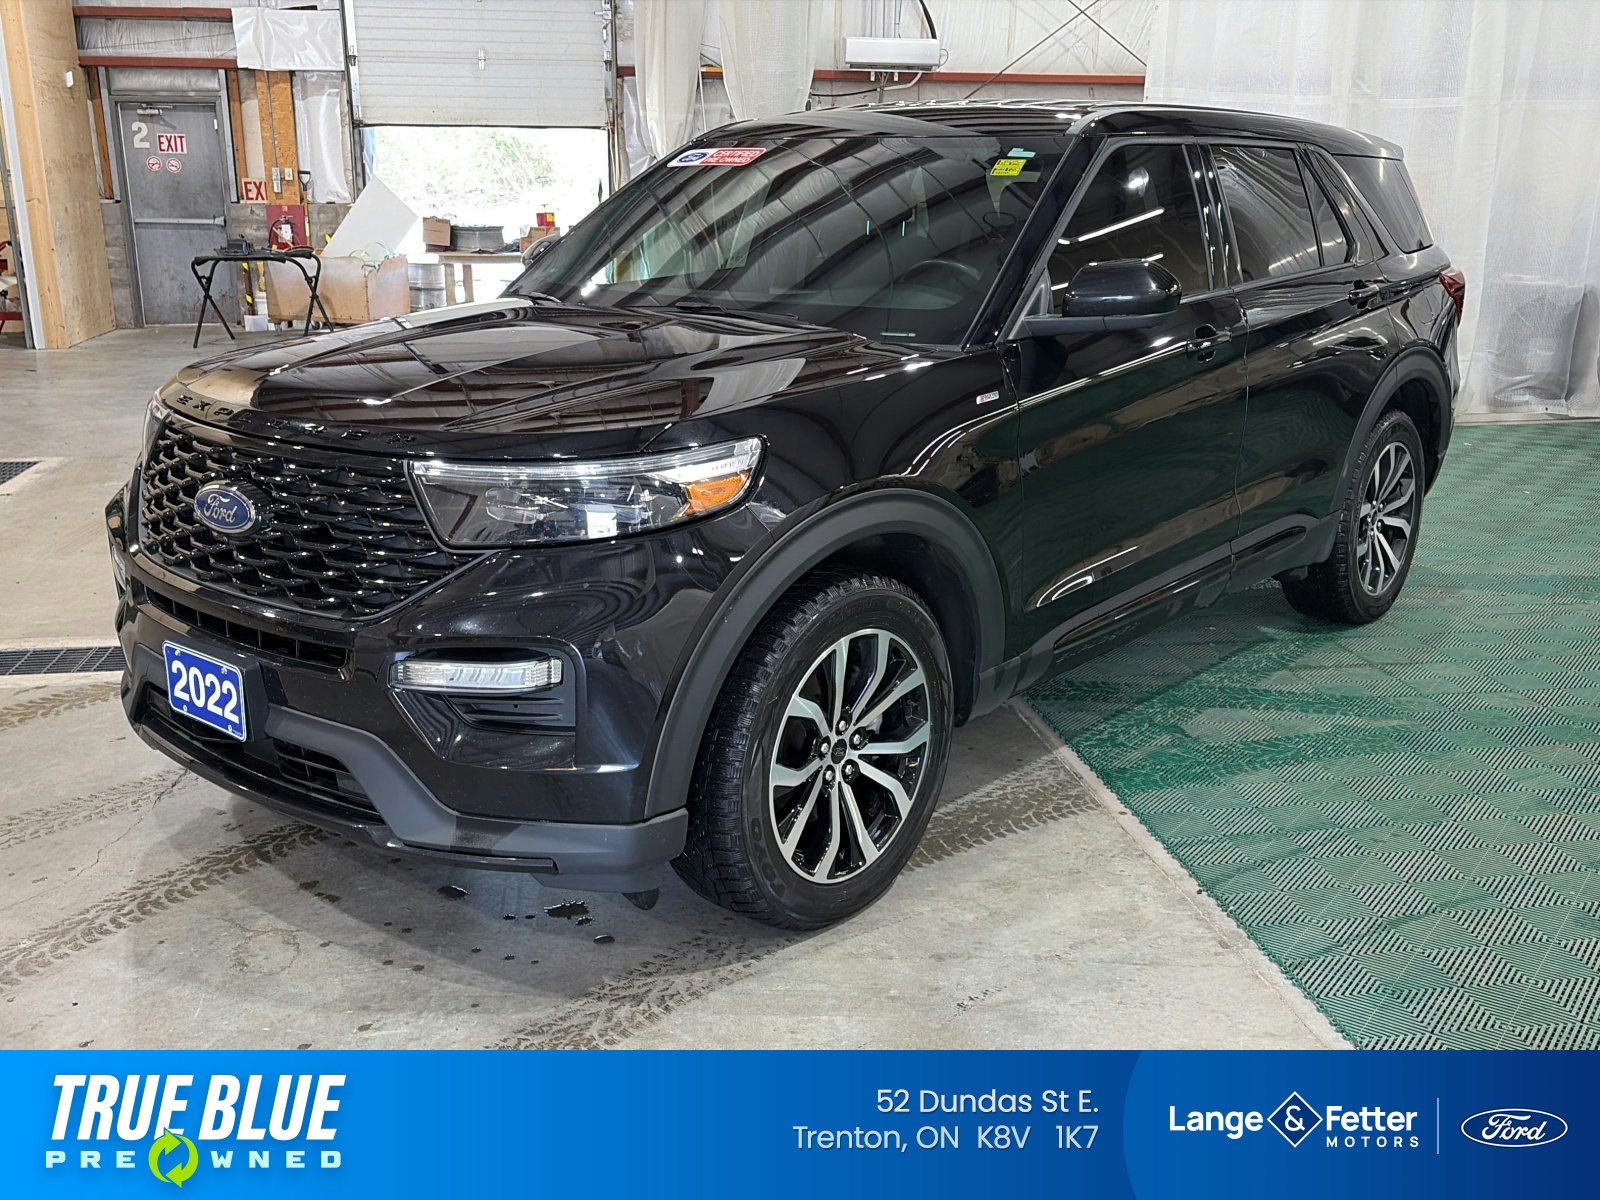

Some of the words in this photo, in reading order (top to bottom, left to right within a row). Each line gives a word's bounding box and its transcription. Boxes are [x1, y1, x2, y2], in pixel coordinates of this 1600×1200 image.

[132, 121, 149, 149] 2
[158, 134, 185, 152] EXIT
[203, 493, 237, 524] Ford
[171, 660, 239, 724] 2022
